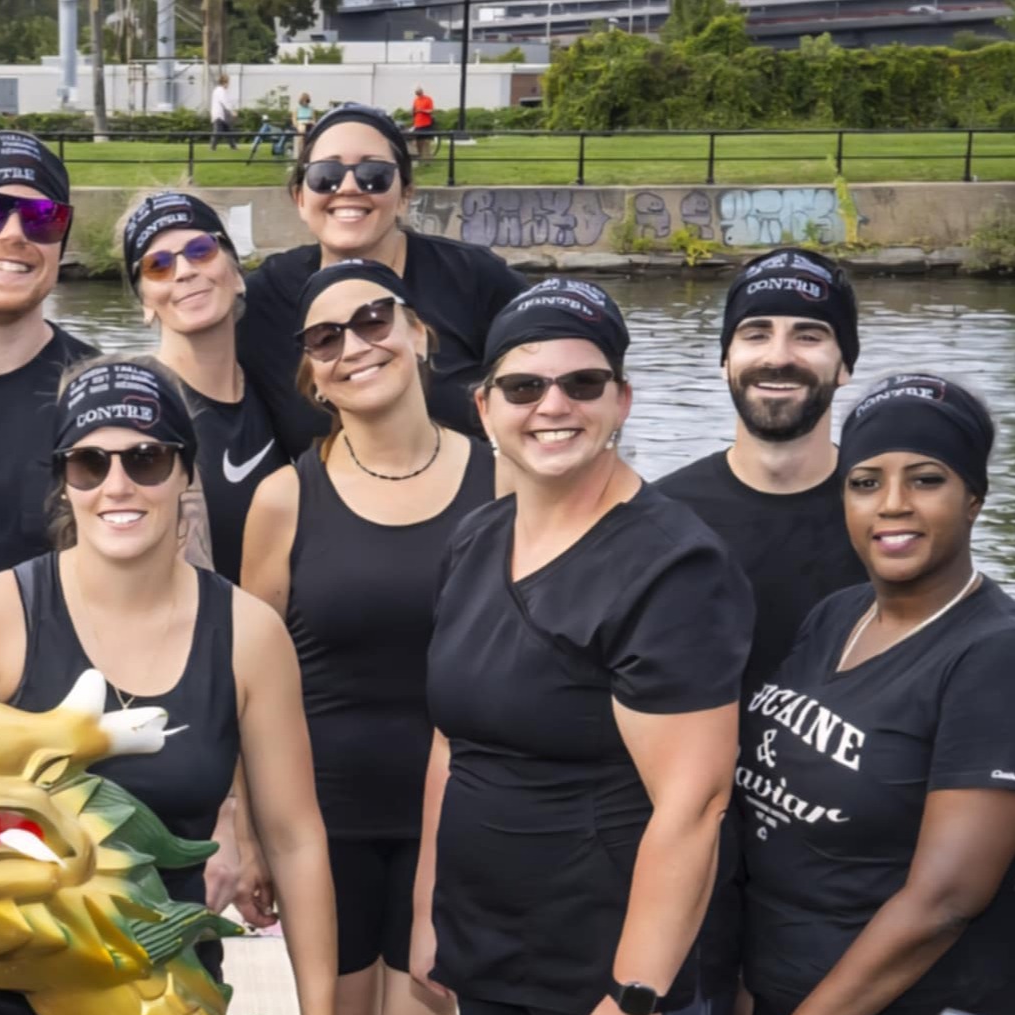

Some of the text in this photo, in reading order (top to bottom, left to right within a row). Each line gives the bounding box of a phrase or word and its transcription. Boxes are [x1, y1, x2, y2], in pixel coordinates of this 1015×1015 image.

[746, 276, 821, 298] CONTRE
[76, 404, 154, 428] CONTRE
[756, 728, 778, 768] &
[735, 766, 851, 823] aviar
